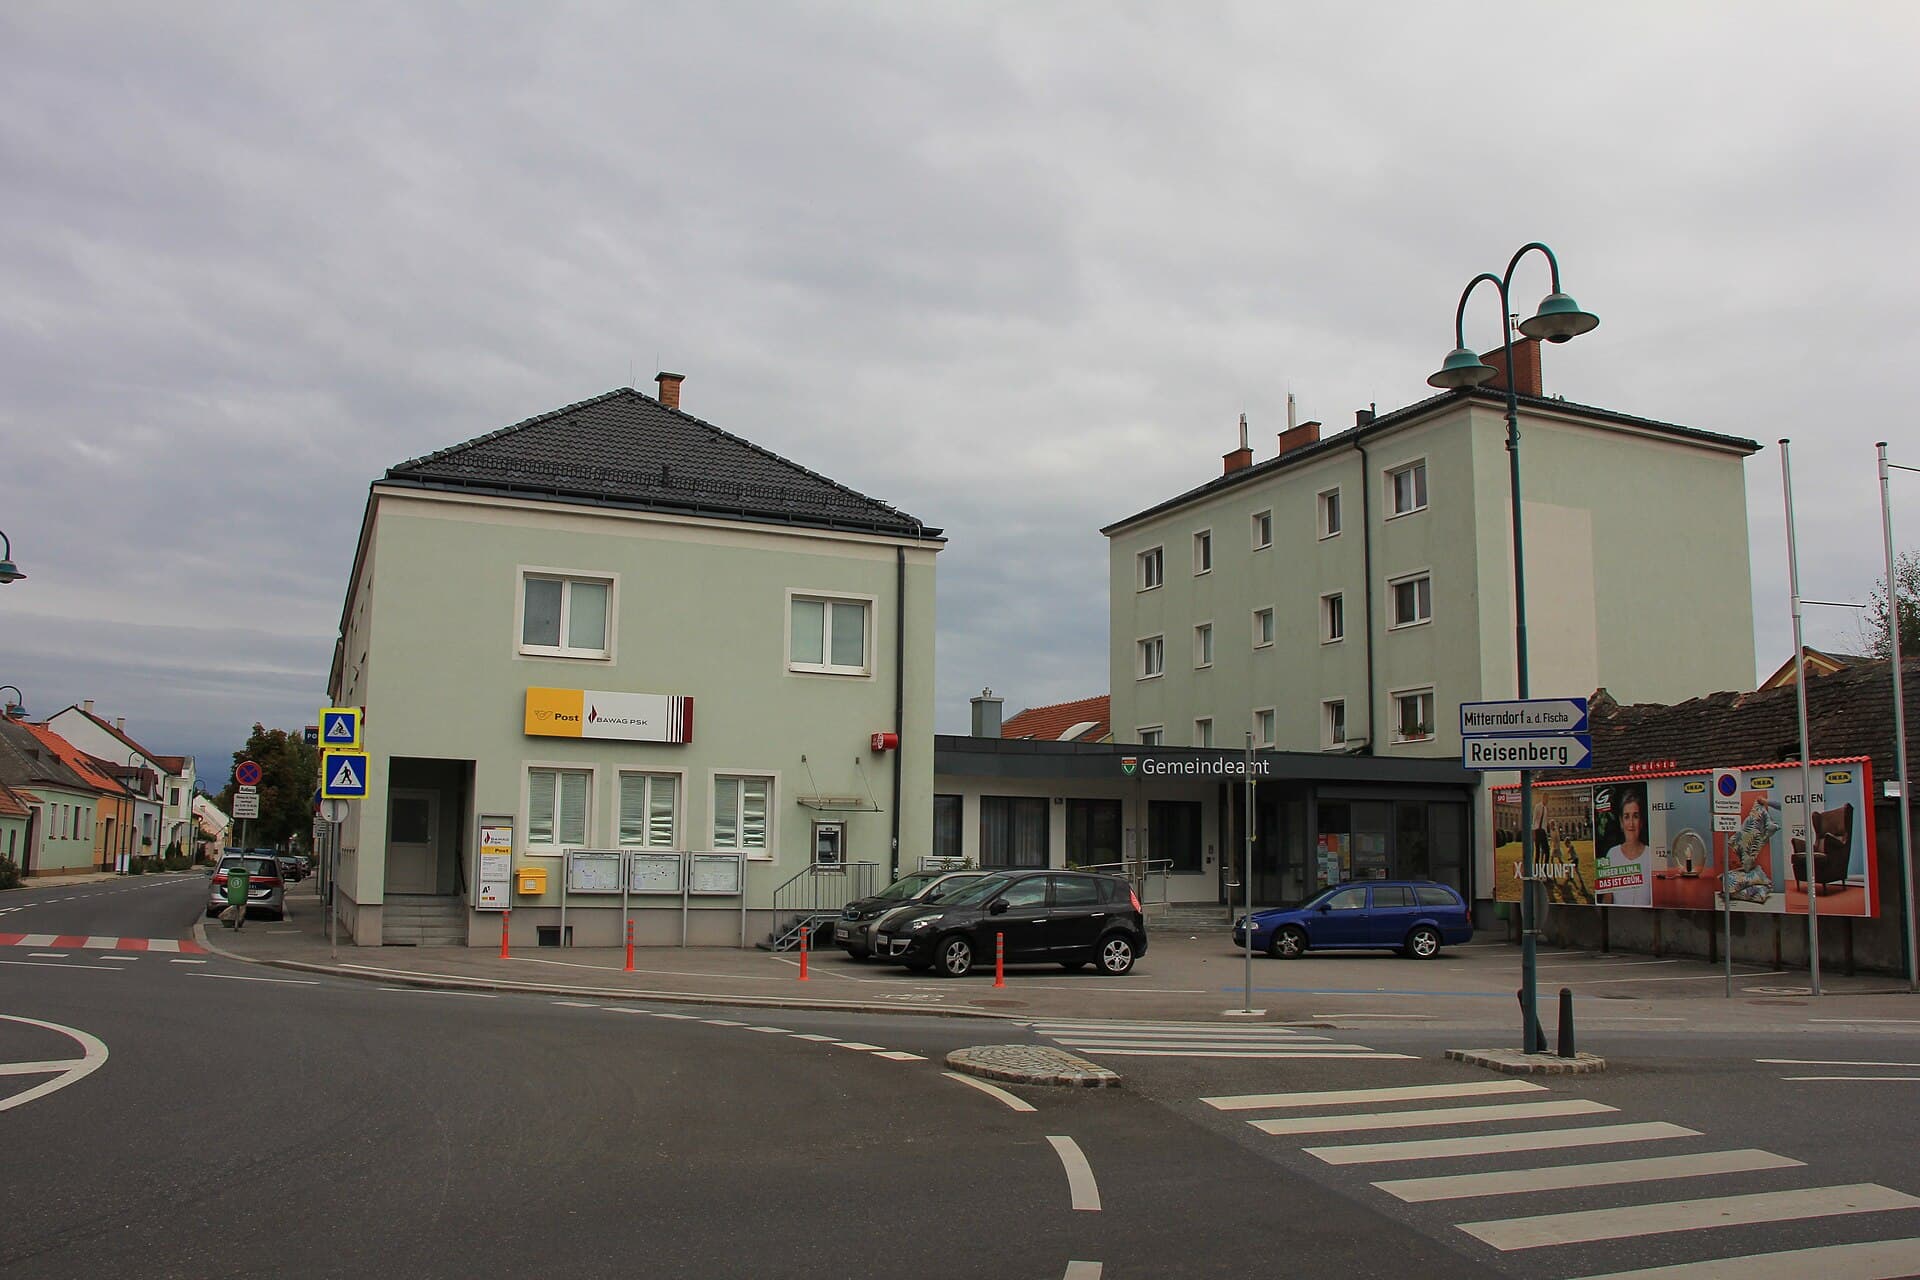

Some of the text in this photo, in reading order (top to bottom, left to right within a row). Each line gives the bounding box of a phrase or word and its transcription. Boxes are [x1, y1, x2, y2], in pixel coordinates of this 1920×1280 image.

[554, 712, 579, 722] Post
[596, 717, 628, 725] BAWAG
[1464, 710, 1525, 726] Mitterndorf
[1543, 712, 1568, 723] Fischa
[1472, 742, 1567, 765] Reisenberg
[1142, 757, 1270, 775] Gemeindeamt
[1599, 879, 1612, 888] DAS
[1612, 877, 1622, 886] IST
